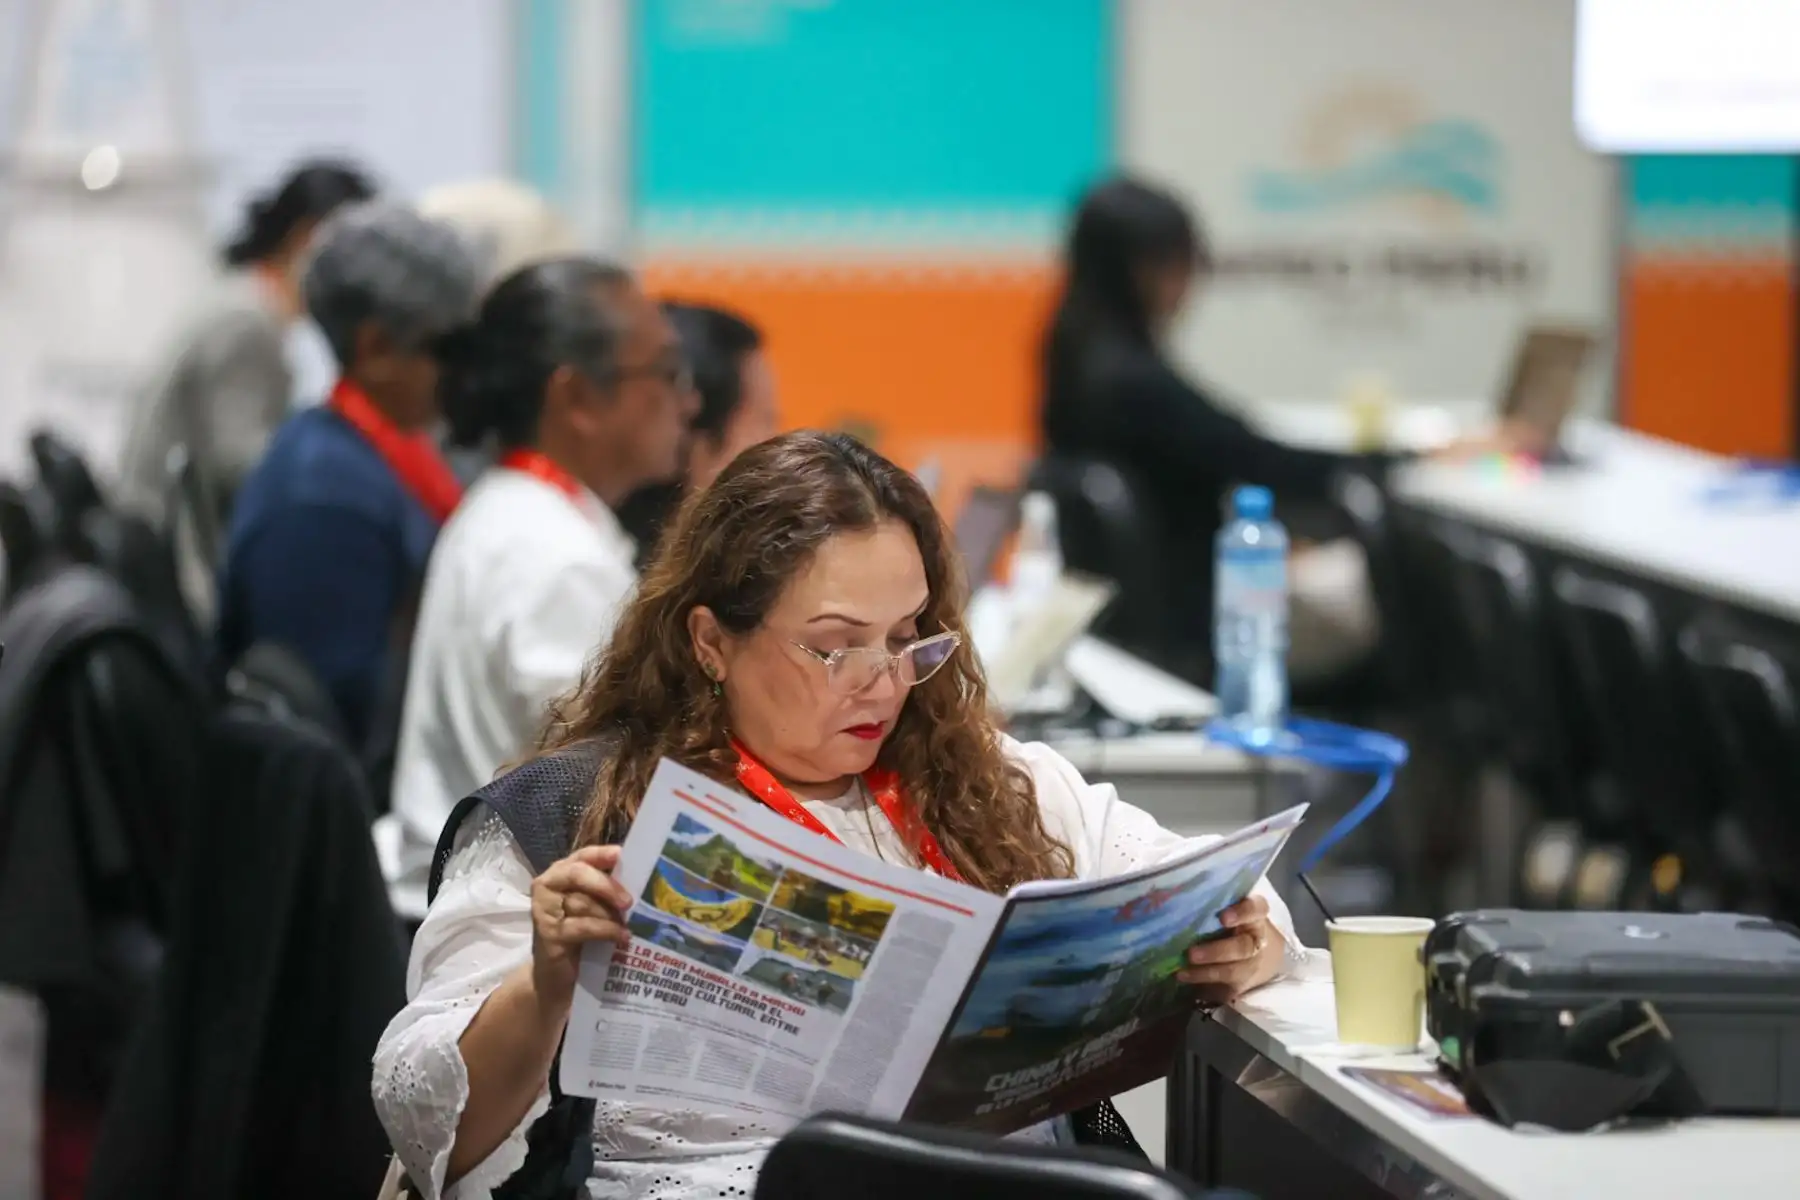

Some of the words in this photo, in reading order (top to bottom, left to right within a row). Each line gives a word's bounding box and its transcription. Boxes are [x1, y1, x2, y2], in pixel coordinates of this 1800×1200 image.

[608, 965, 693, 996] INTERCAMBIO
[695, 989, 757, 1020] CULTURAL
[760, 1013, 801, 1036] ENTRE
[635, 945, 652, 958] LA
[654, 952, 687, 970] GRAN
[689, 965, 748, 994] MURALLA
[750, 990, 760, 998] A
[761, 994, 806, 1016] MACHU
[643, 986, 652, 998] Y
[662, 966, 680, 979] UN
[682, 974, 731, 997] PUENTE
[734, 993, 767, 1012] PARA
[769, 1007, 782, 1018] EL
